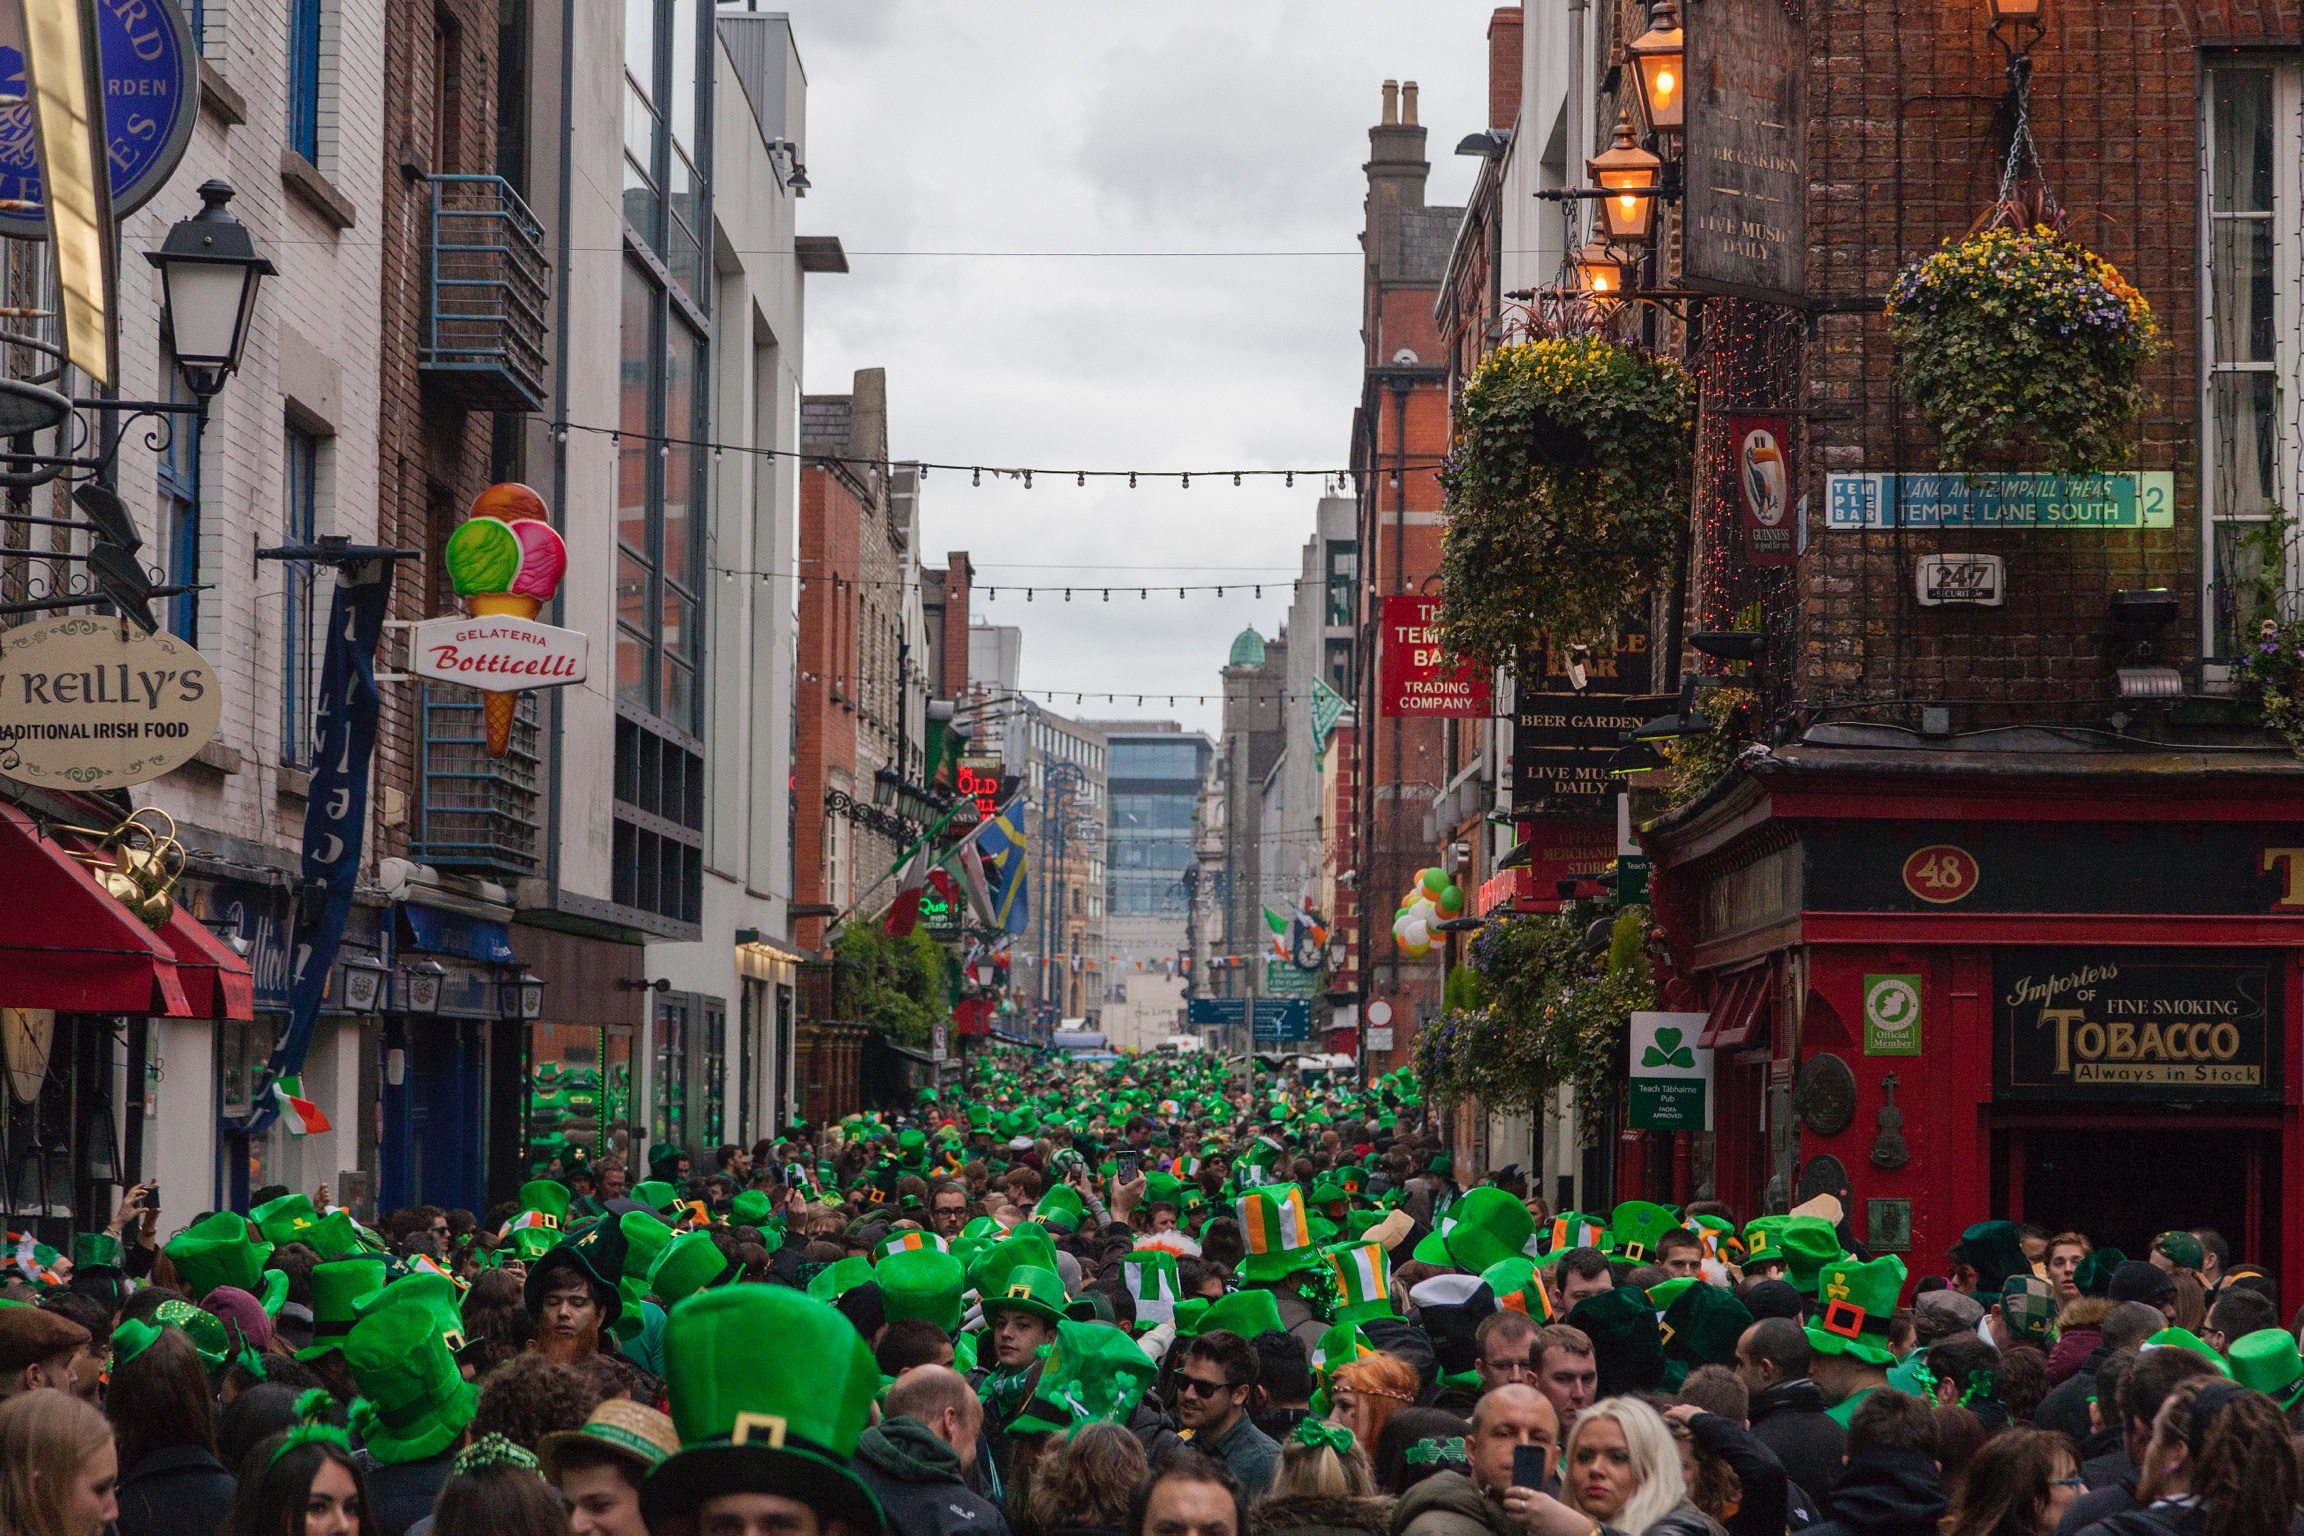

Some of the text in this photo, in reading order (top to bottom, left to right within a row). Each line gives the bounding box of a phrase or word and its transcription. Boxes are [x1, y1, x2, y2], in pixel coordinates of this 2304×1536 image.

[1723, 239, 1768, 260] DAILY
[1947, 481, 1971, 498] AN
[2146, 486, 2164, 513] 2
[1835, 508, 1876, 521] BAR
[1900, 503, 2119, 521] TEMPLE LANE SOUTH
[1752, 528, 1790, 541] GUINNESS
[456, 628, 547, 647] GELATERIA
[1395, 626, 1446, 644] TEM
[429, 645, 576, 677] Botticelli
[1404, 681, 1470, 694] TRADING
[1400, 696, 1473, 709] COMPANY
[93, 722, 139, 739] IRISH
[145, 721, 189, 738] FOOD
[1521, 714, 1644, 729] BEER GARDEN
[1527, 766, 1570, 780] LIVE
[957, 775, 998, 795] OLD
[1554, 781, 1609, 795] DAILY
[1543, 846, 1618, 861] MERCHANDI
[1626, 861, 1646, 870] Teach
[1915, 854, 1963, 888] 48
[2006, 961, 2118, 1007] Importers
[2077, 988, 2096, 1001] OF
[2106, 999, 2240, 1016] FINE SMOKING
[2036, 1007, 2241, 1076] TOBACCO
[2078, 1065, 2256, 1083] Always in Stock
[1639, 1084, 1660, 1093] Teach
[1660, 1095, 1675, 1103] Pub
